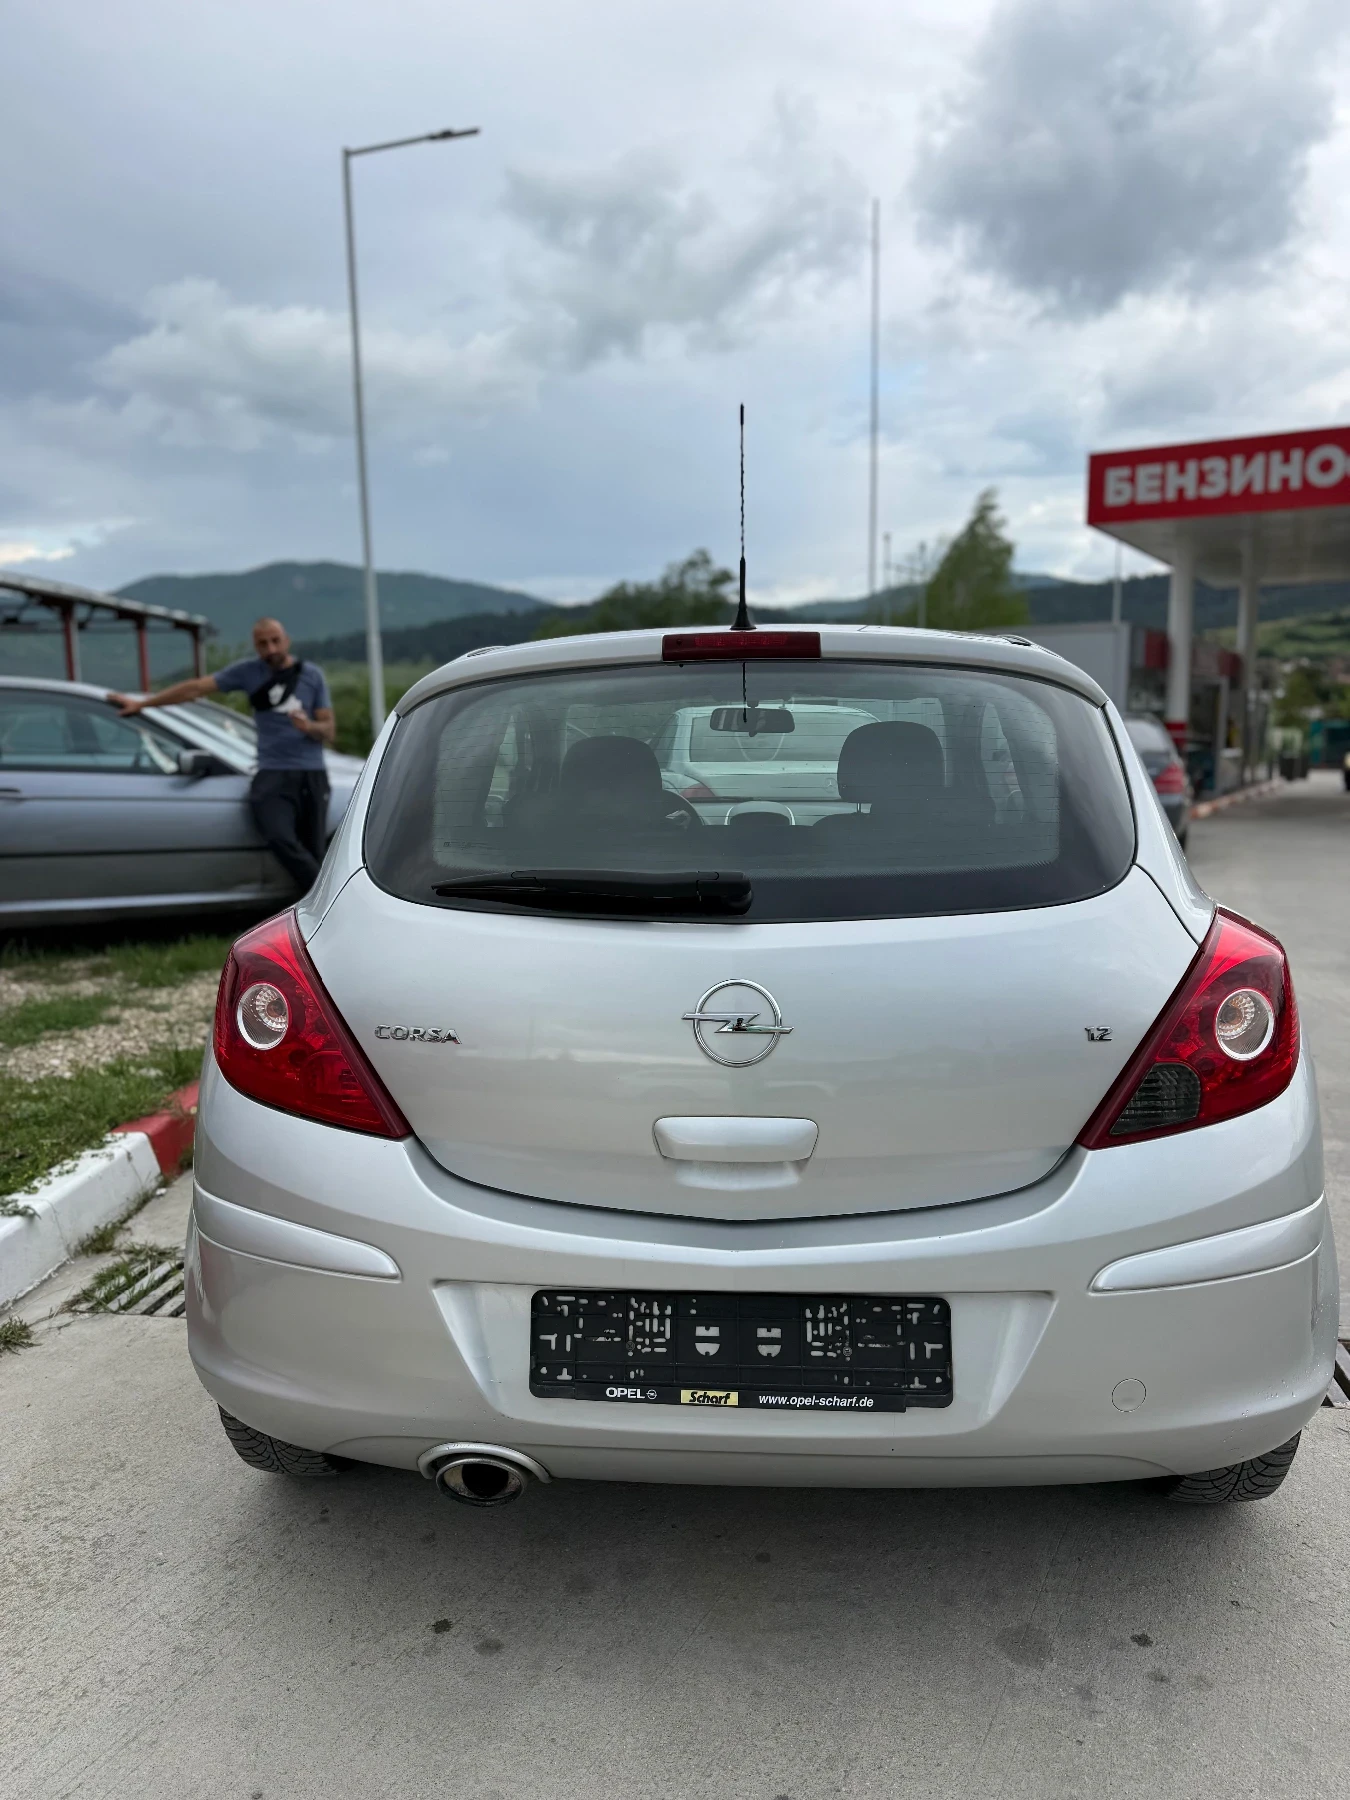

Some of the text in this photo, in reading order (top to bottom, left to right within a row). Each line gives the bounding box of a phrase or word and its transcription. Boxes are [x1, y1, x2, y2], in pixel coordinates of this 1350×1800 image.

[1102, 443, 1350, 507] БЕНЗИНО
[374, 1024, 462, 1045] CORSA
[605, 1386, 874, 1408] OPEL Scharf www.opel-scharf.de
